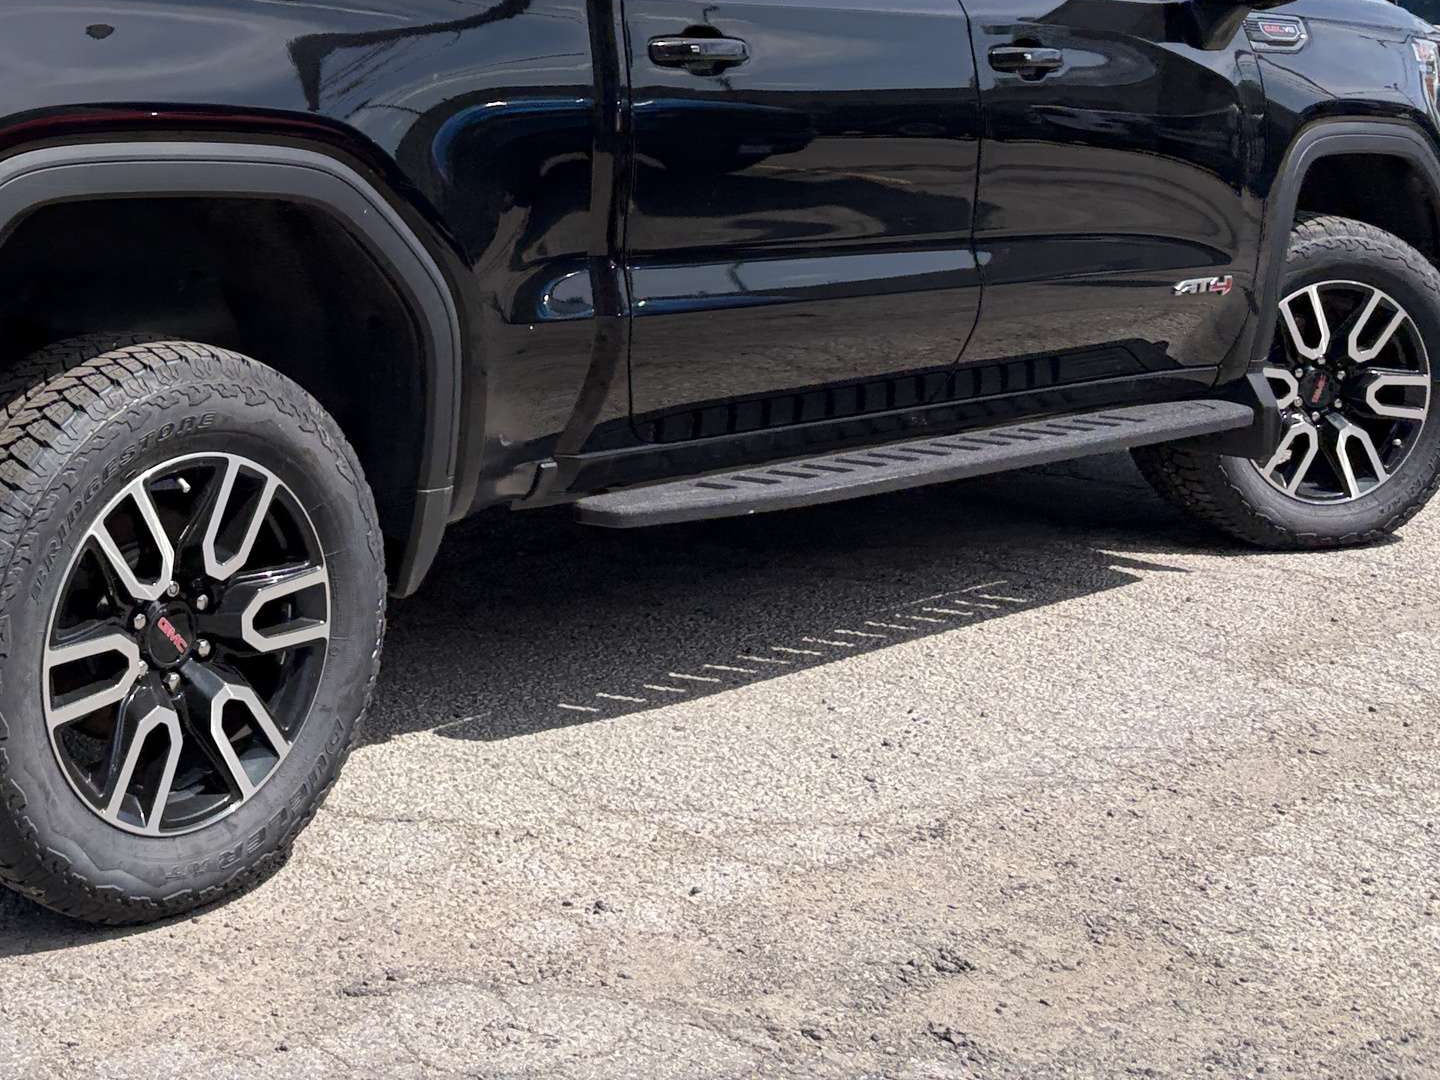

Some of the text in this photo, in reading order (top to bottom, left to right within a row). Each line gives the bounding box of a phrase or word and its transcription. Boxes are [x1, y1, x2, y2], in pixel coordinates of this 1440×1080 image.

[1174, 275, 1232, 297] AT4
[28, 410, 216, 607] BRIDGESTONE
[157, 616, 188, 655] GMC
